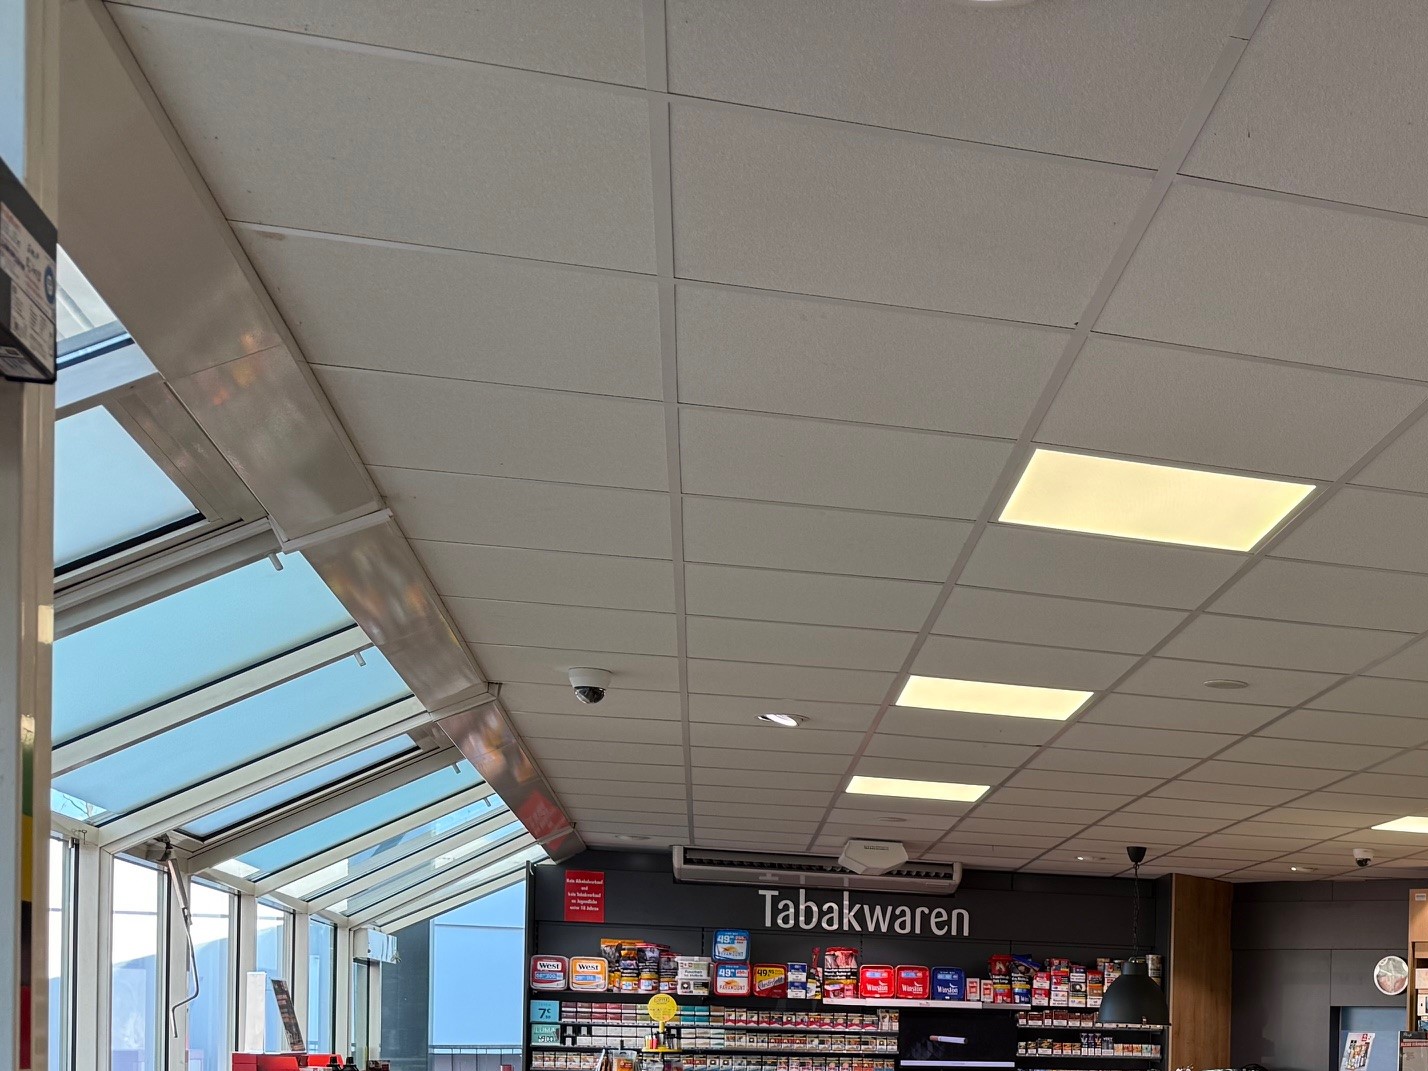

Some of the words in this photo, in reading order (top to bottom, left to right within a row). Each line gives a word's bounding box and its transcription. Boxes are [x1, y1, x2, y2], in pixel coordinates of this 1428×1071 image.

[758, 888, 971, 937] Tabakwaren
[538, 962, 560, 970] West
[866, 983, 888, 993] Winston
[901, 983, 923, 993] Winston
[936, 985, 958, 994] Winston
